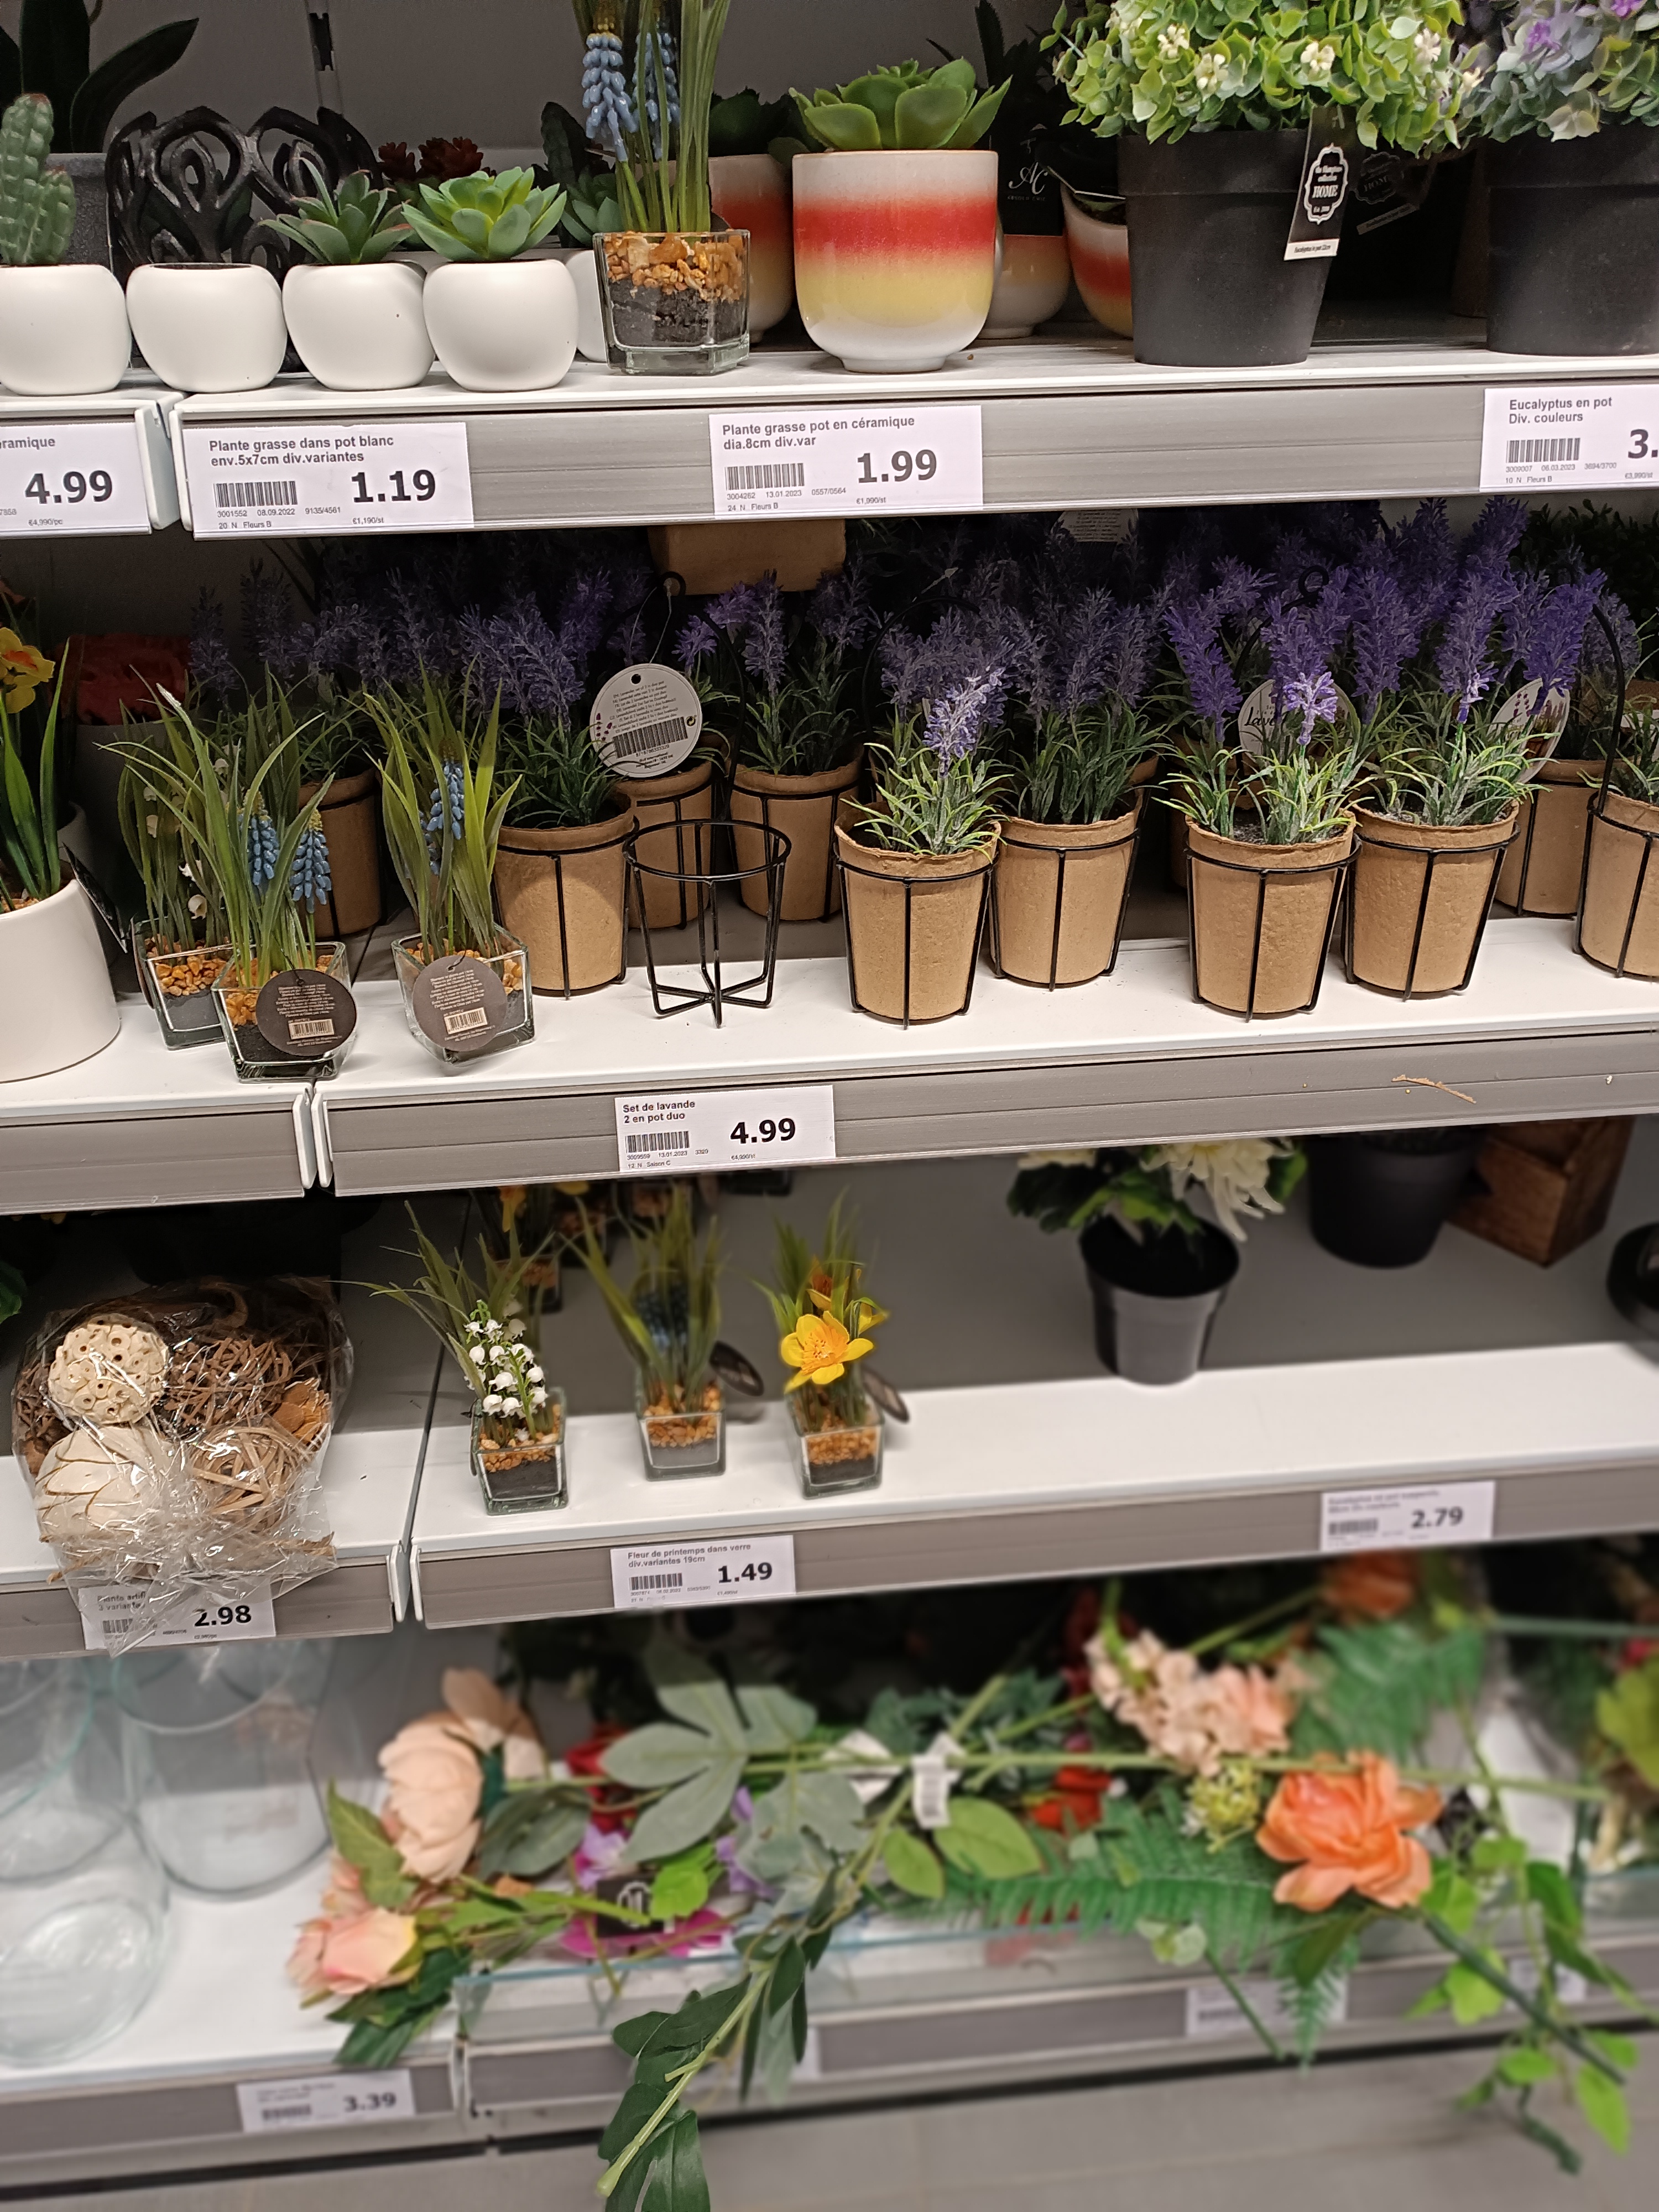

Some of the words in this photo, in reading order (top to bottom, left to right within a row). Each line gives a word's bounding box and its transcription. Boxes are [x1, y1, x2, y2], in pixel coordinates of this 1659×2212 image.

[1510, 398, 1572, 411] Eucalyptus
[1594, 397, 1612, 409] pot
[723, 424, 761, 435] Plante
[765, 422, 806, 436] grasse
[810, 420, 830, 432] pot
[833, 420, 848, 429] en
[852, 416, 915, 429] céramique
[1509, 413, 1531, 424] Div.
[1534, 413, 1583, 423] couleurs
[0, 436, 55, 450] ramique
[209, 440, 249, 452] Plante
[253, 440, 296, 452] grasse
[300, 437, 331, 448] dans
[335, 437, 356, 450] pot
[359, 436, 394, 447] blanc
[723, 439, 771, 450] dia.8cm
[775, 436, 816, 447] div.var
[1627, 429, 1659, 459] 3.
[211, 454, 279, 466] env.5x7cm
[283, 451, 364, 464] div.variantes
[857, 449, 937, 483] 1.99
[25, 470, 113, 504] 4.99
[351, 469, 436, 503] 1.19
[623, 1104, 640, 1113] Set
[642, 1103, 654, 1112] de
[656, 1100, 696, 1110] lavande
[624, 1115, 630, 1124] 2
[648, 1113, 664, 1124] pot
[666, 1112, 685, 1120] duo
[730, 1117, 796, 1145] 4.99
[1411, 1506, 1463, 1529] 2.79
[628, 1551, 649, 1559] Fleur
[651, 1550, 661, 1558] de
[664, 1548, 705, 1558] printemps
[707, 1545, 728, 1553] dans
[628, 1558, 681, 1568] div.variantes
[718, 1562, 773, 1584] 1.49
[194, 1605, 251, 1627] 2.98
[344, 2091, 397, 2112] 3.39
